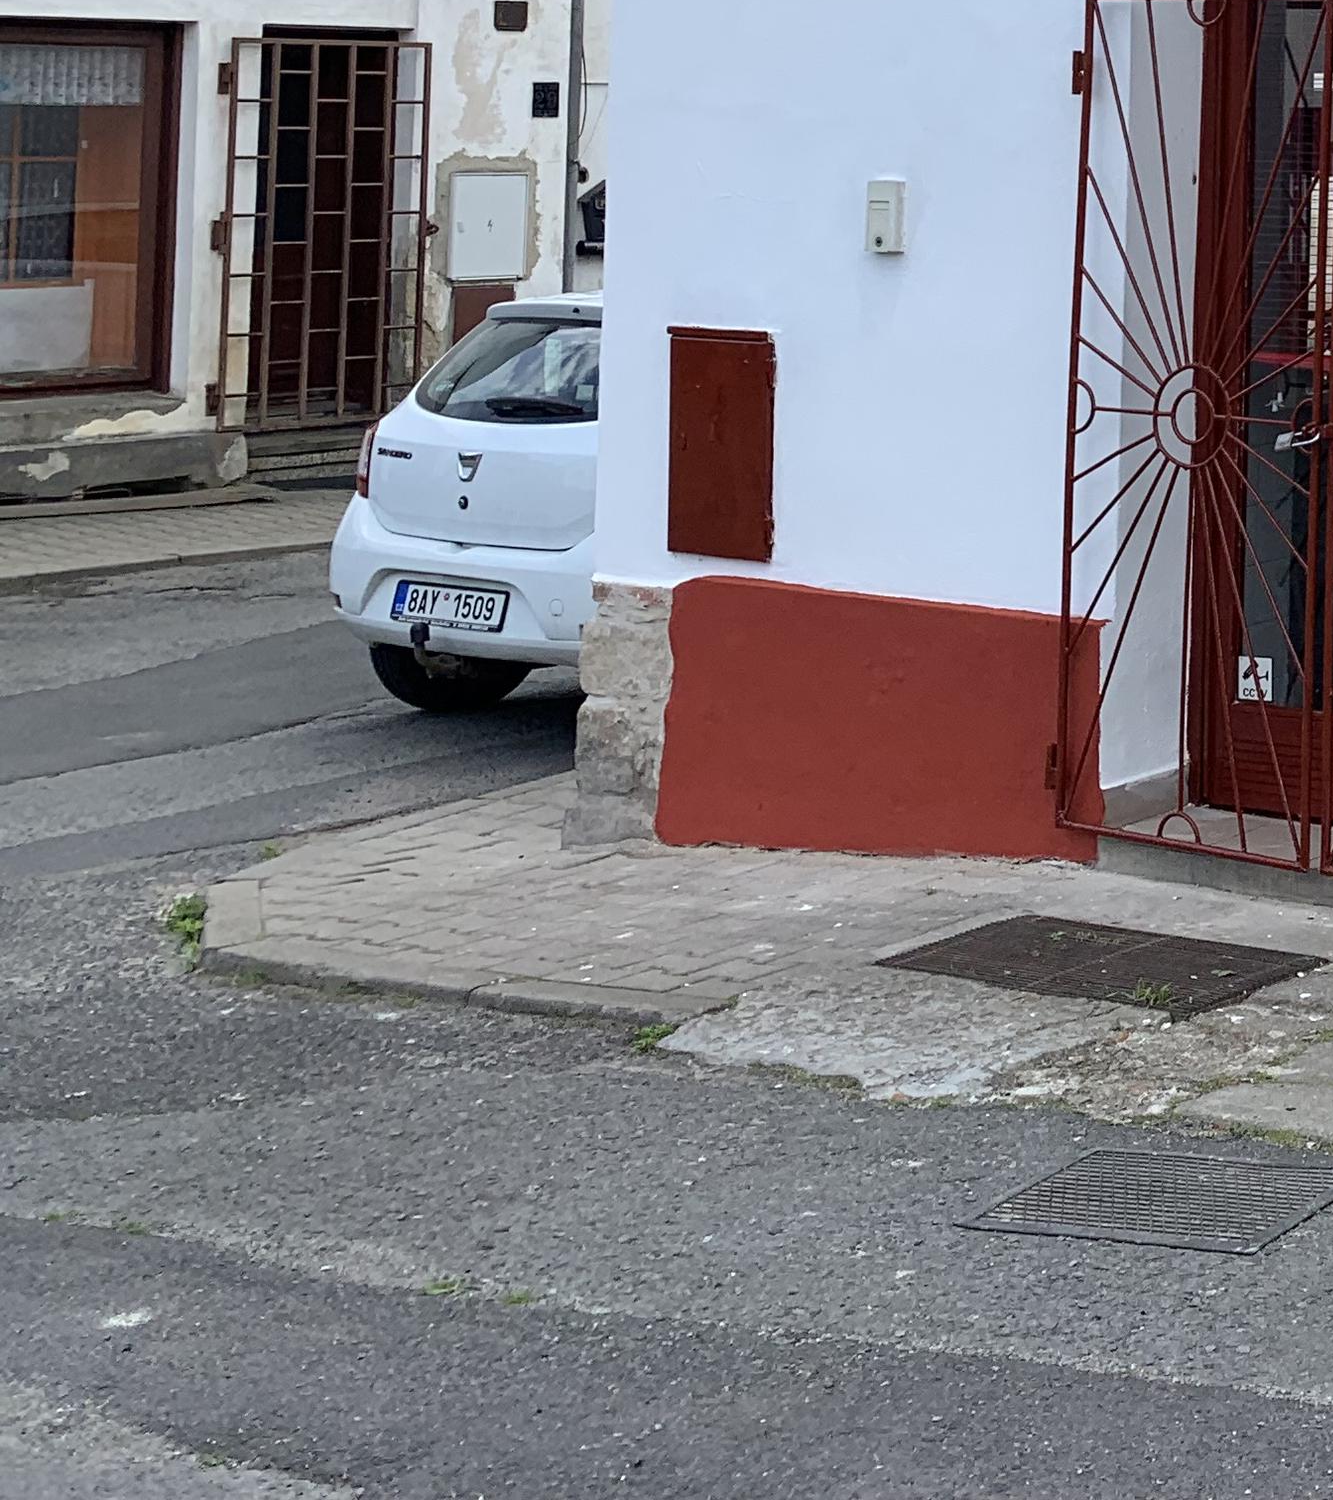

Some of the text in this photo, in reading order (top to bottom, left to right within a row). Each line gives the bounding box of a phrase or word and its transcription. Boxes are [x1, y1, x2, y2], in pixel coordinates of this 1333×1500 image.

[408, 588, 496, 622] 8AY 1509
[1243, 687, 1268, 699] CCV
